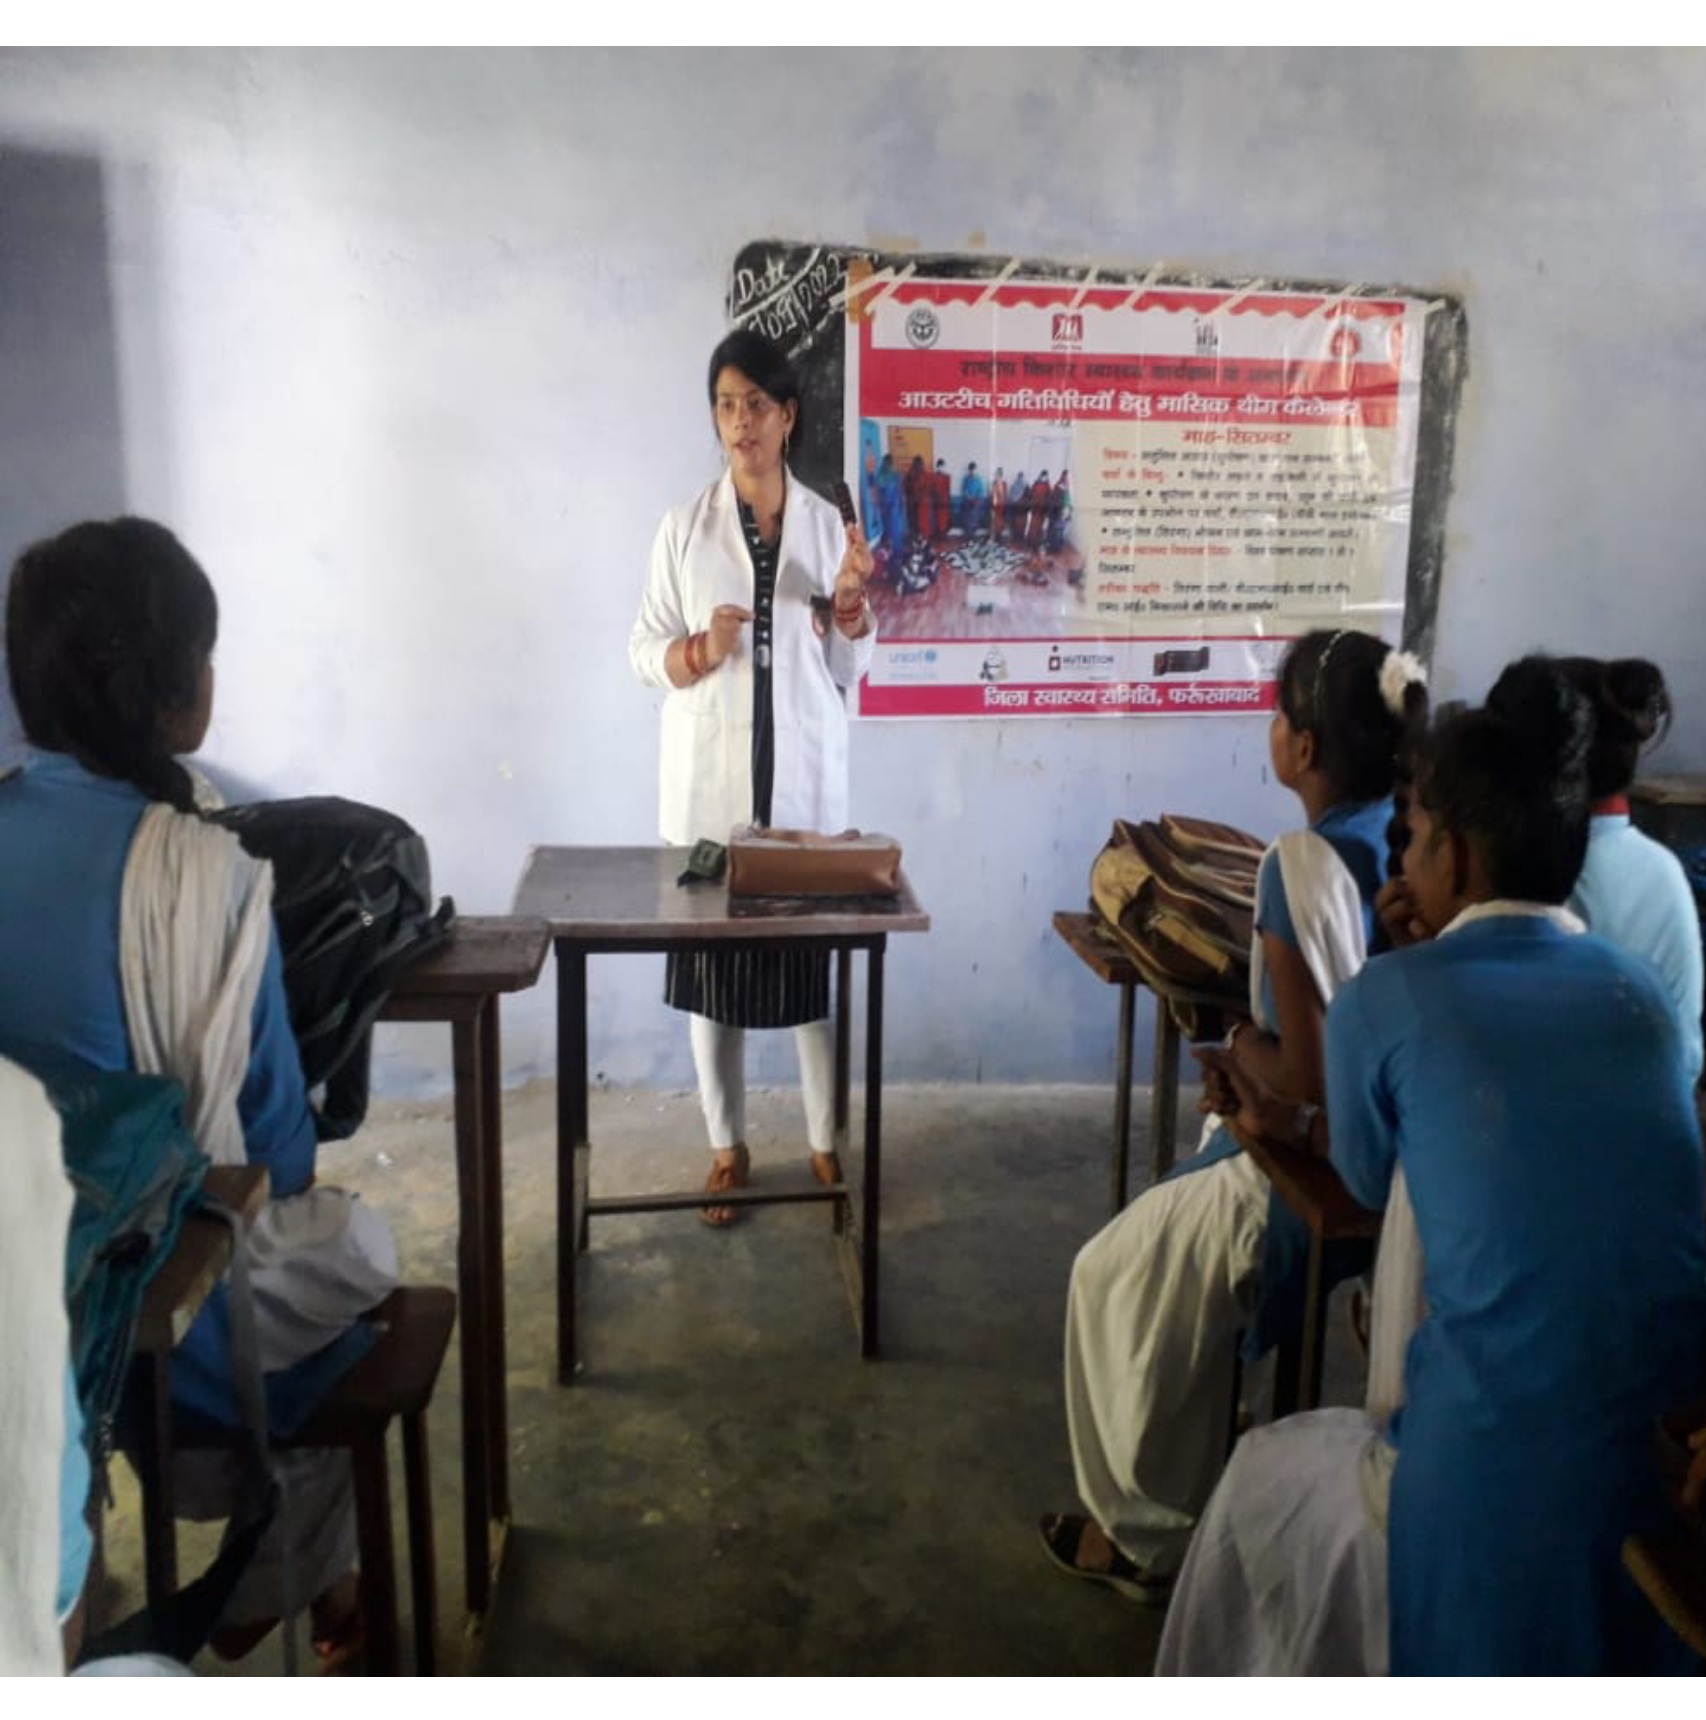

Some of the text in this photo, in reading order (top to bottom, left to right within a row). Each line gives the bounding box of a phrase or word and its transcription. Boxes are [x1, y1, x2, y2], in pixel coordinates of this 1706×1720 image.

[738, 257, 790, 307] Date
[898, 387, 992, 411] आउटरीच
[997, 388, 1114, 413] गतिविधियों
[1119, 391, 1152, 418] हेतु
[1157, 391, 1232, 415] मासिक
[984, 684, 1029, 706] जिला
[1034, 688, 1097, 705] स्वास्थ्य
